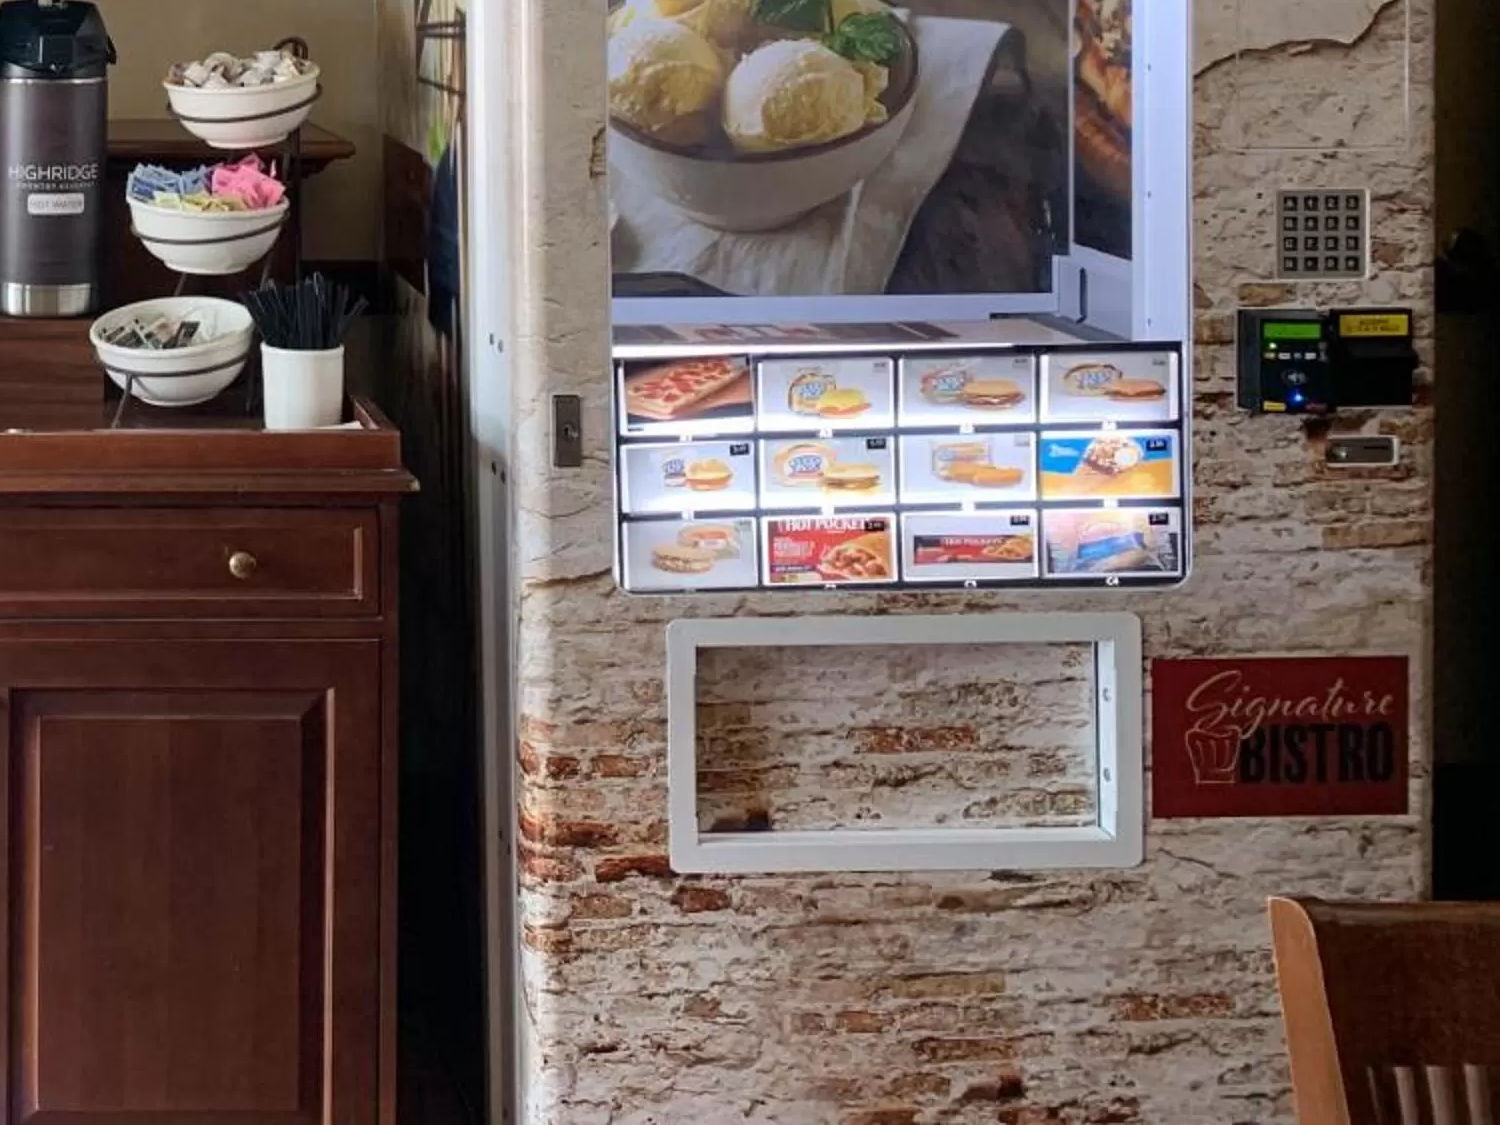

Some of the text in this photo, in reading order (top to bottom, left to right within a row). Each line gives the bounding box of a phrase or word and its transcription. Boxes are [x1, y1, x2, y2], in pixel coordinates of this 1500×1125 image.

[8, 163, 100, 180] HIGHRIDGE
[1186, 670, 1393, 740] Signature
[1240, 723, 1393, 784] BISTRO
